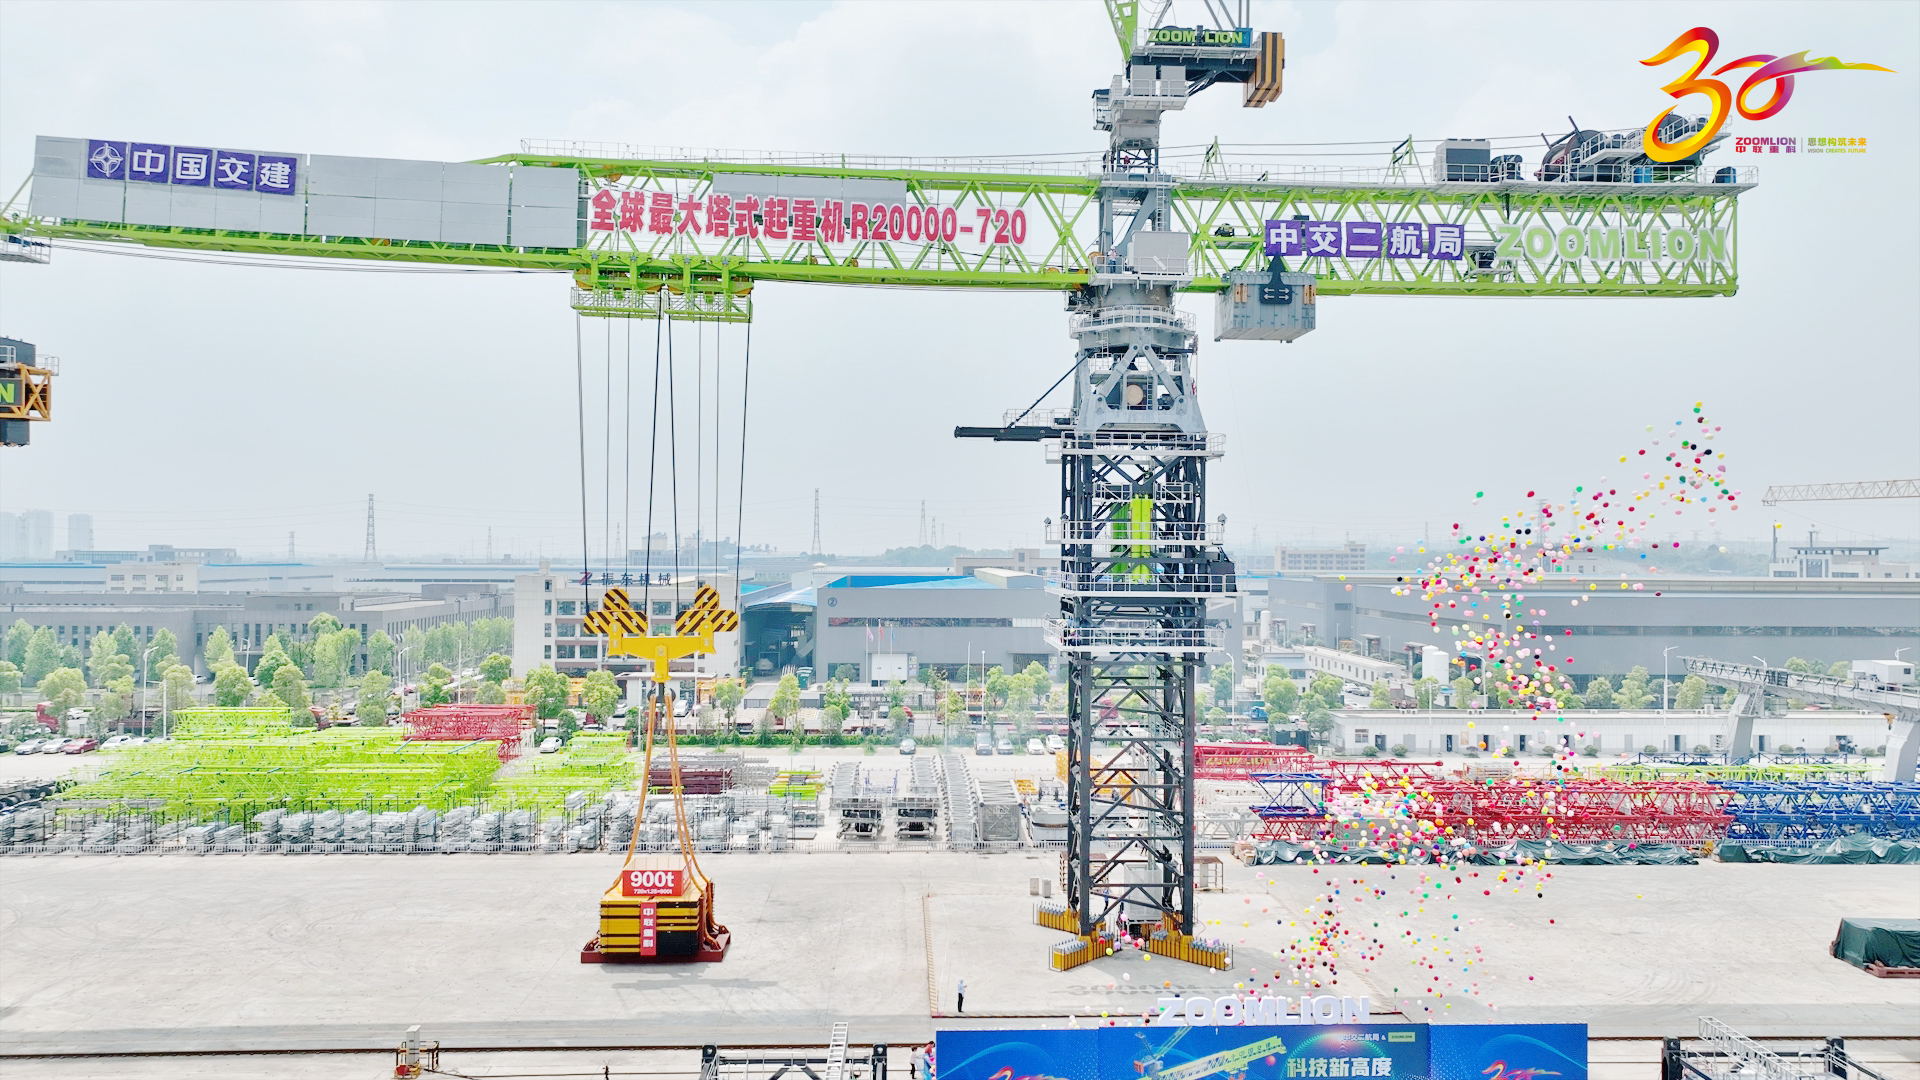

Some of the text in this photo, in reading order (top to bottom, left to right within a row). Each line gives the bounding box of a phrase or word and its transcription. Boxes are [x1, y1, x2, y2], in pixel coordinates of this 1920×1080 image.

[1148, 29, 1243, 44] ZOOMLION
[132, 146, 291, 190] 中国交建
[590, 189, 1027, 246] 全球最大塔式起重机R20000-720
[1268, 222, 1463, 258] 中交二航局
[1497, 225, 1726, 262] ZOOMLION
[630, 871, 675, 888] 900t
[1157, 995, 1370, 1026] ZOOMLION
[1287, 1057, 1393, 1079] 科技新高度
